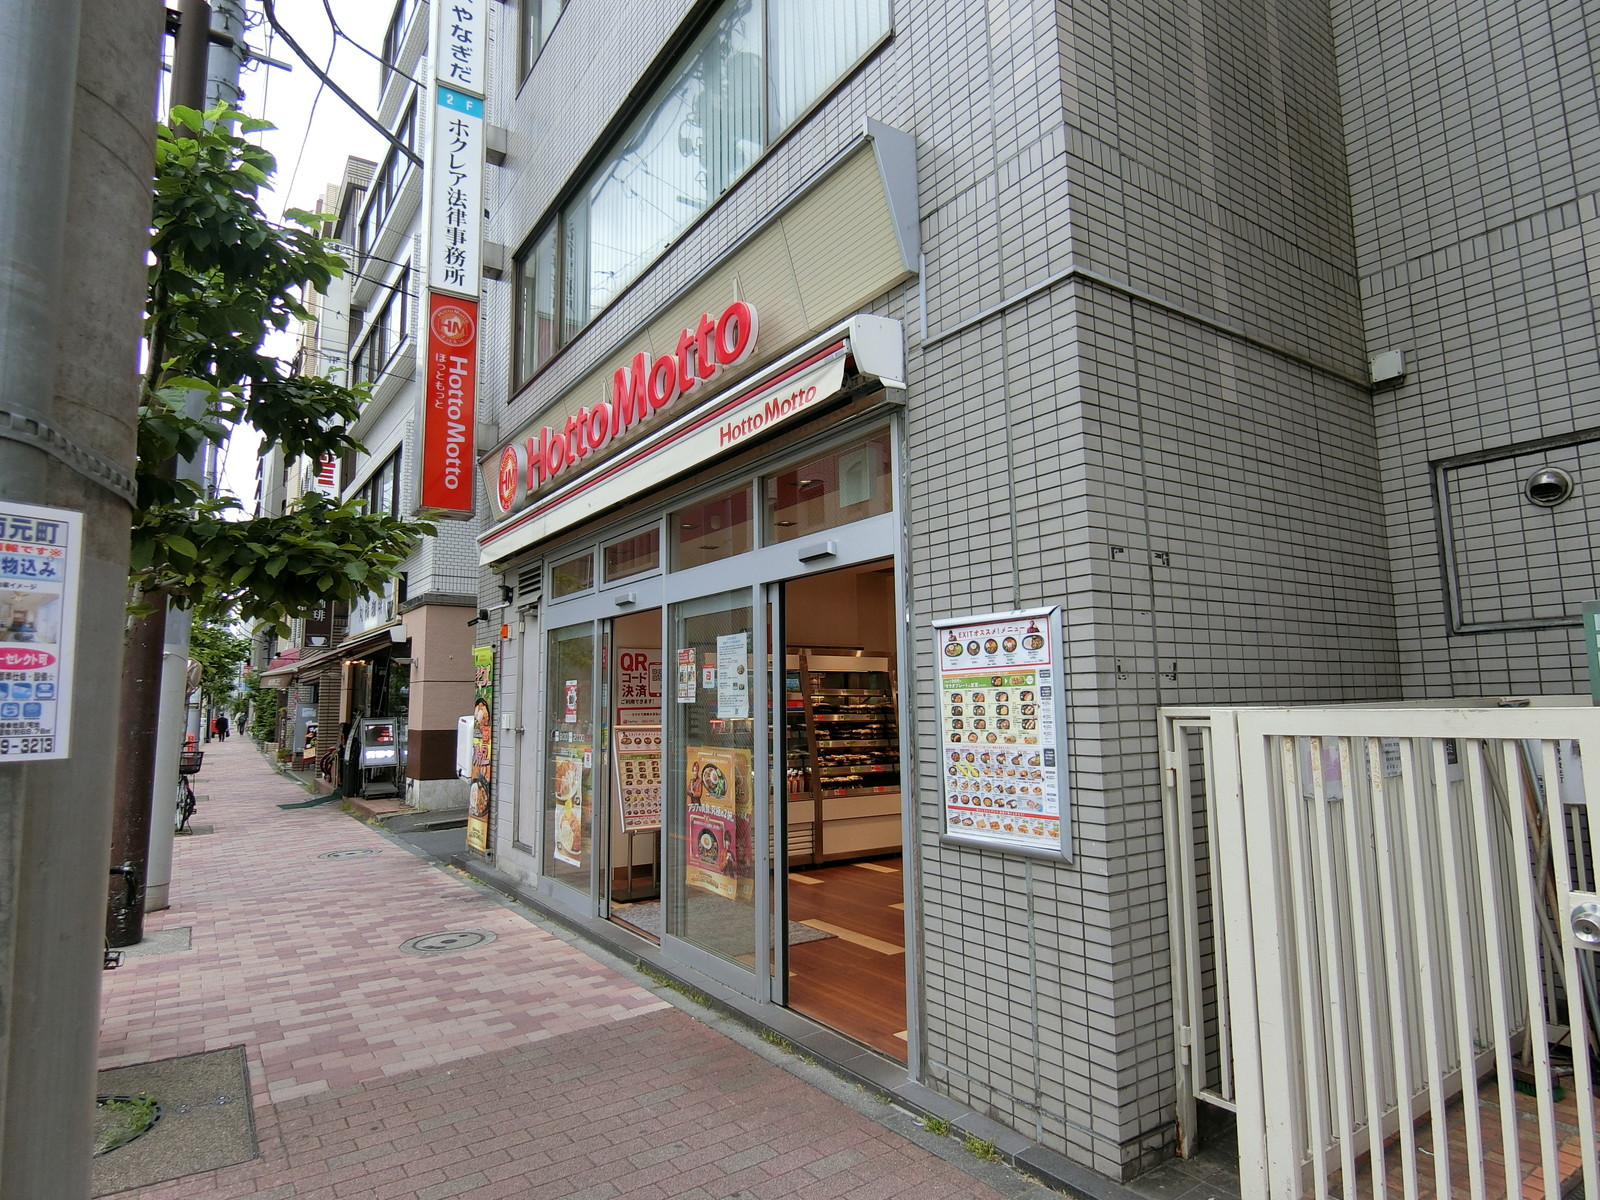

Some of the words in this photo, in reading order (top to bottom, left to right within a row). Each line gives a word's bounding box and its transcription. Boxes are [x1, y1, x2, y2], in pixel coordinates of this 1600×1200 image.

[450, 0, 473, 84] やなぎだ
[443, 117, 470, 288] ホクレア法律事務所
[434, 353, 446, 410] ほっともっと
[527, 301, 760, 491] HottoMotto
[444, 355, 469, 490] HottoMotto
[719, 384, 817, 448] HottoMotto
[2, 556, 56, 577] 物込み
[621, 652, 648, 672] QR
[622, 672, 647, 684] コード
[622, 684, 647, 698] 決済
